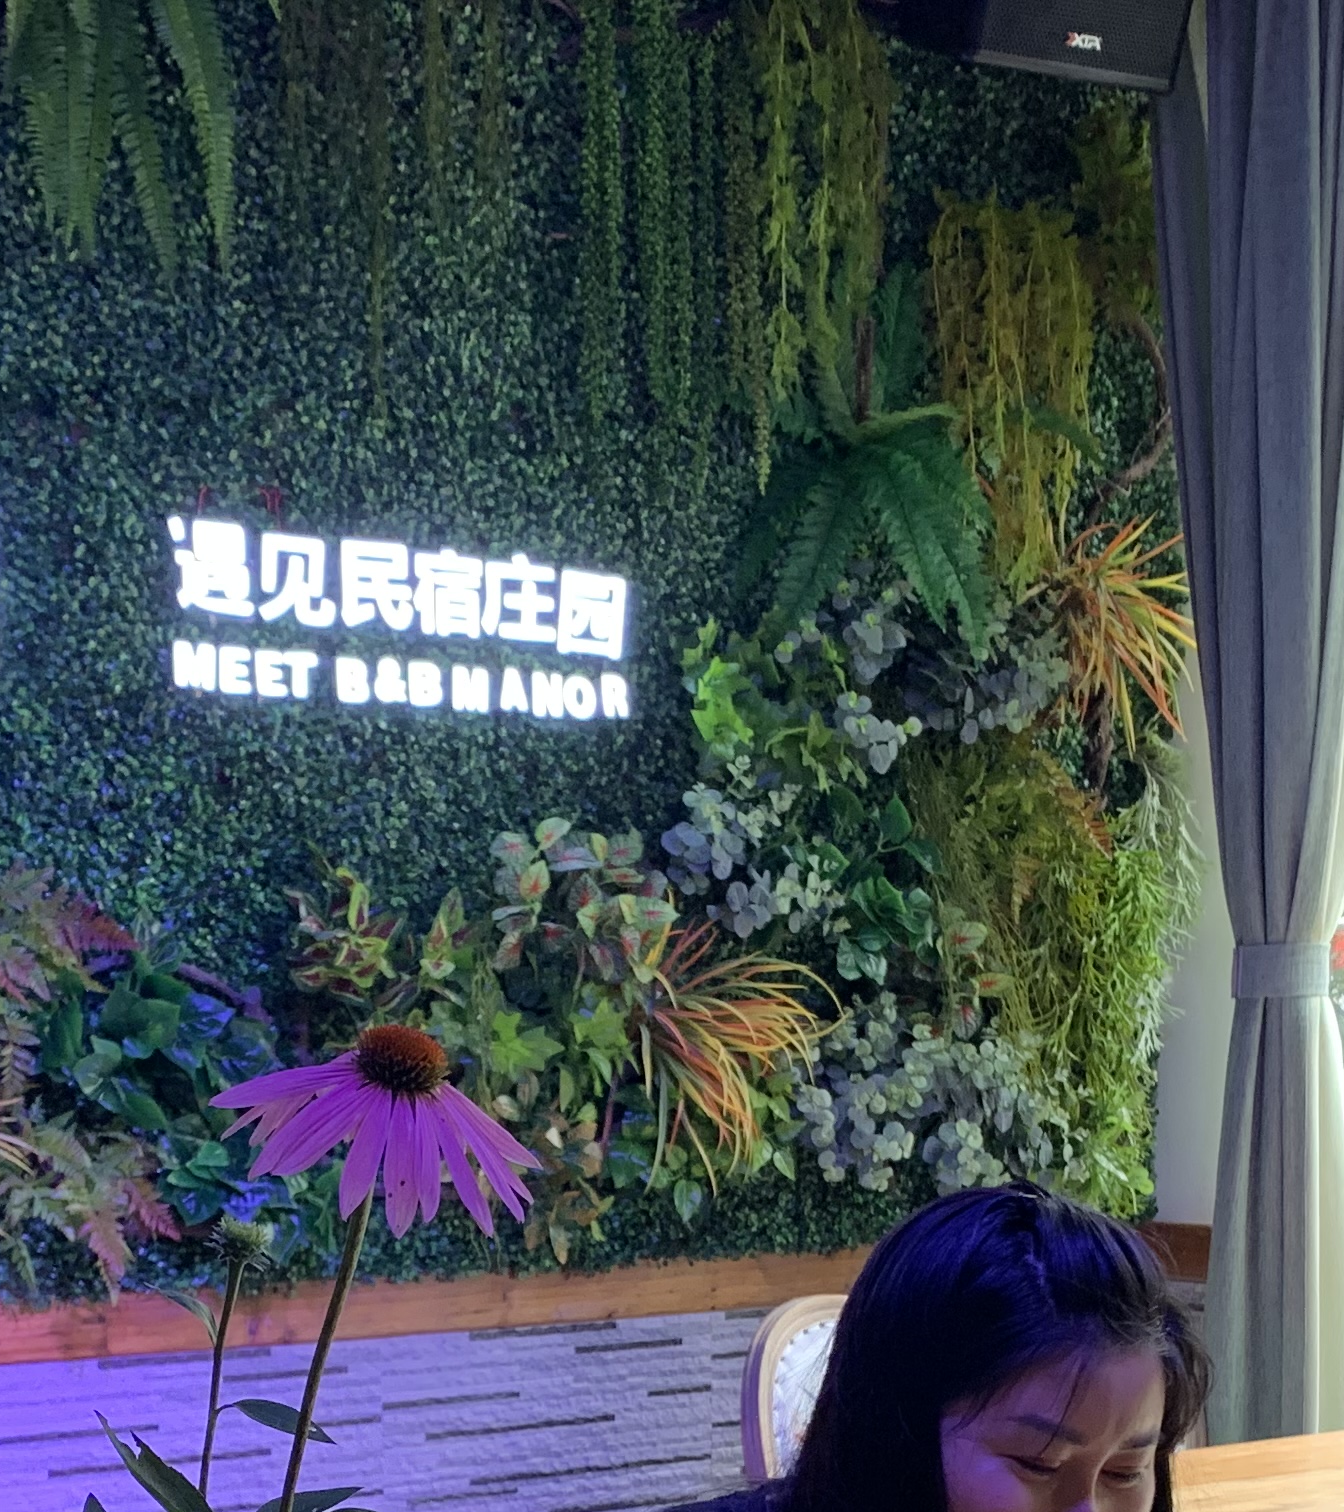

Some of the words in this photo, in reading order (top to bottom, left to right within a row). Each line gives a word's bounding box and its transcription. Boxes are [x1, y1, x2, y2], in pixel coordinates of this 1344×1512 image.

[167, 515, 628, 660] 遇见民宿庄园
[172, 640, 319, 699] MEET
[335, 657, 444, 706] B&B
[451, 664, 630, 720] MANOR
